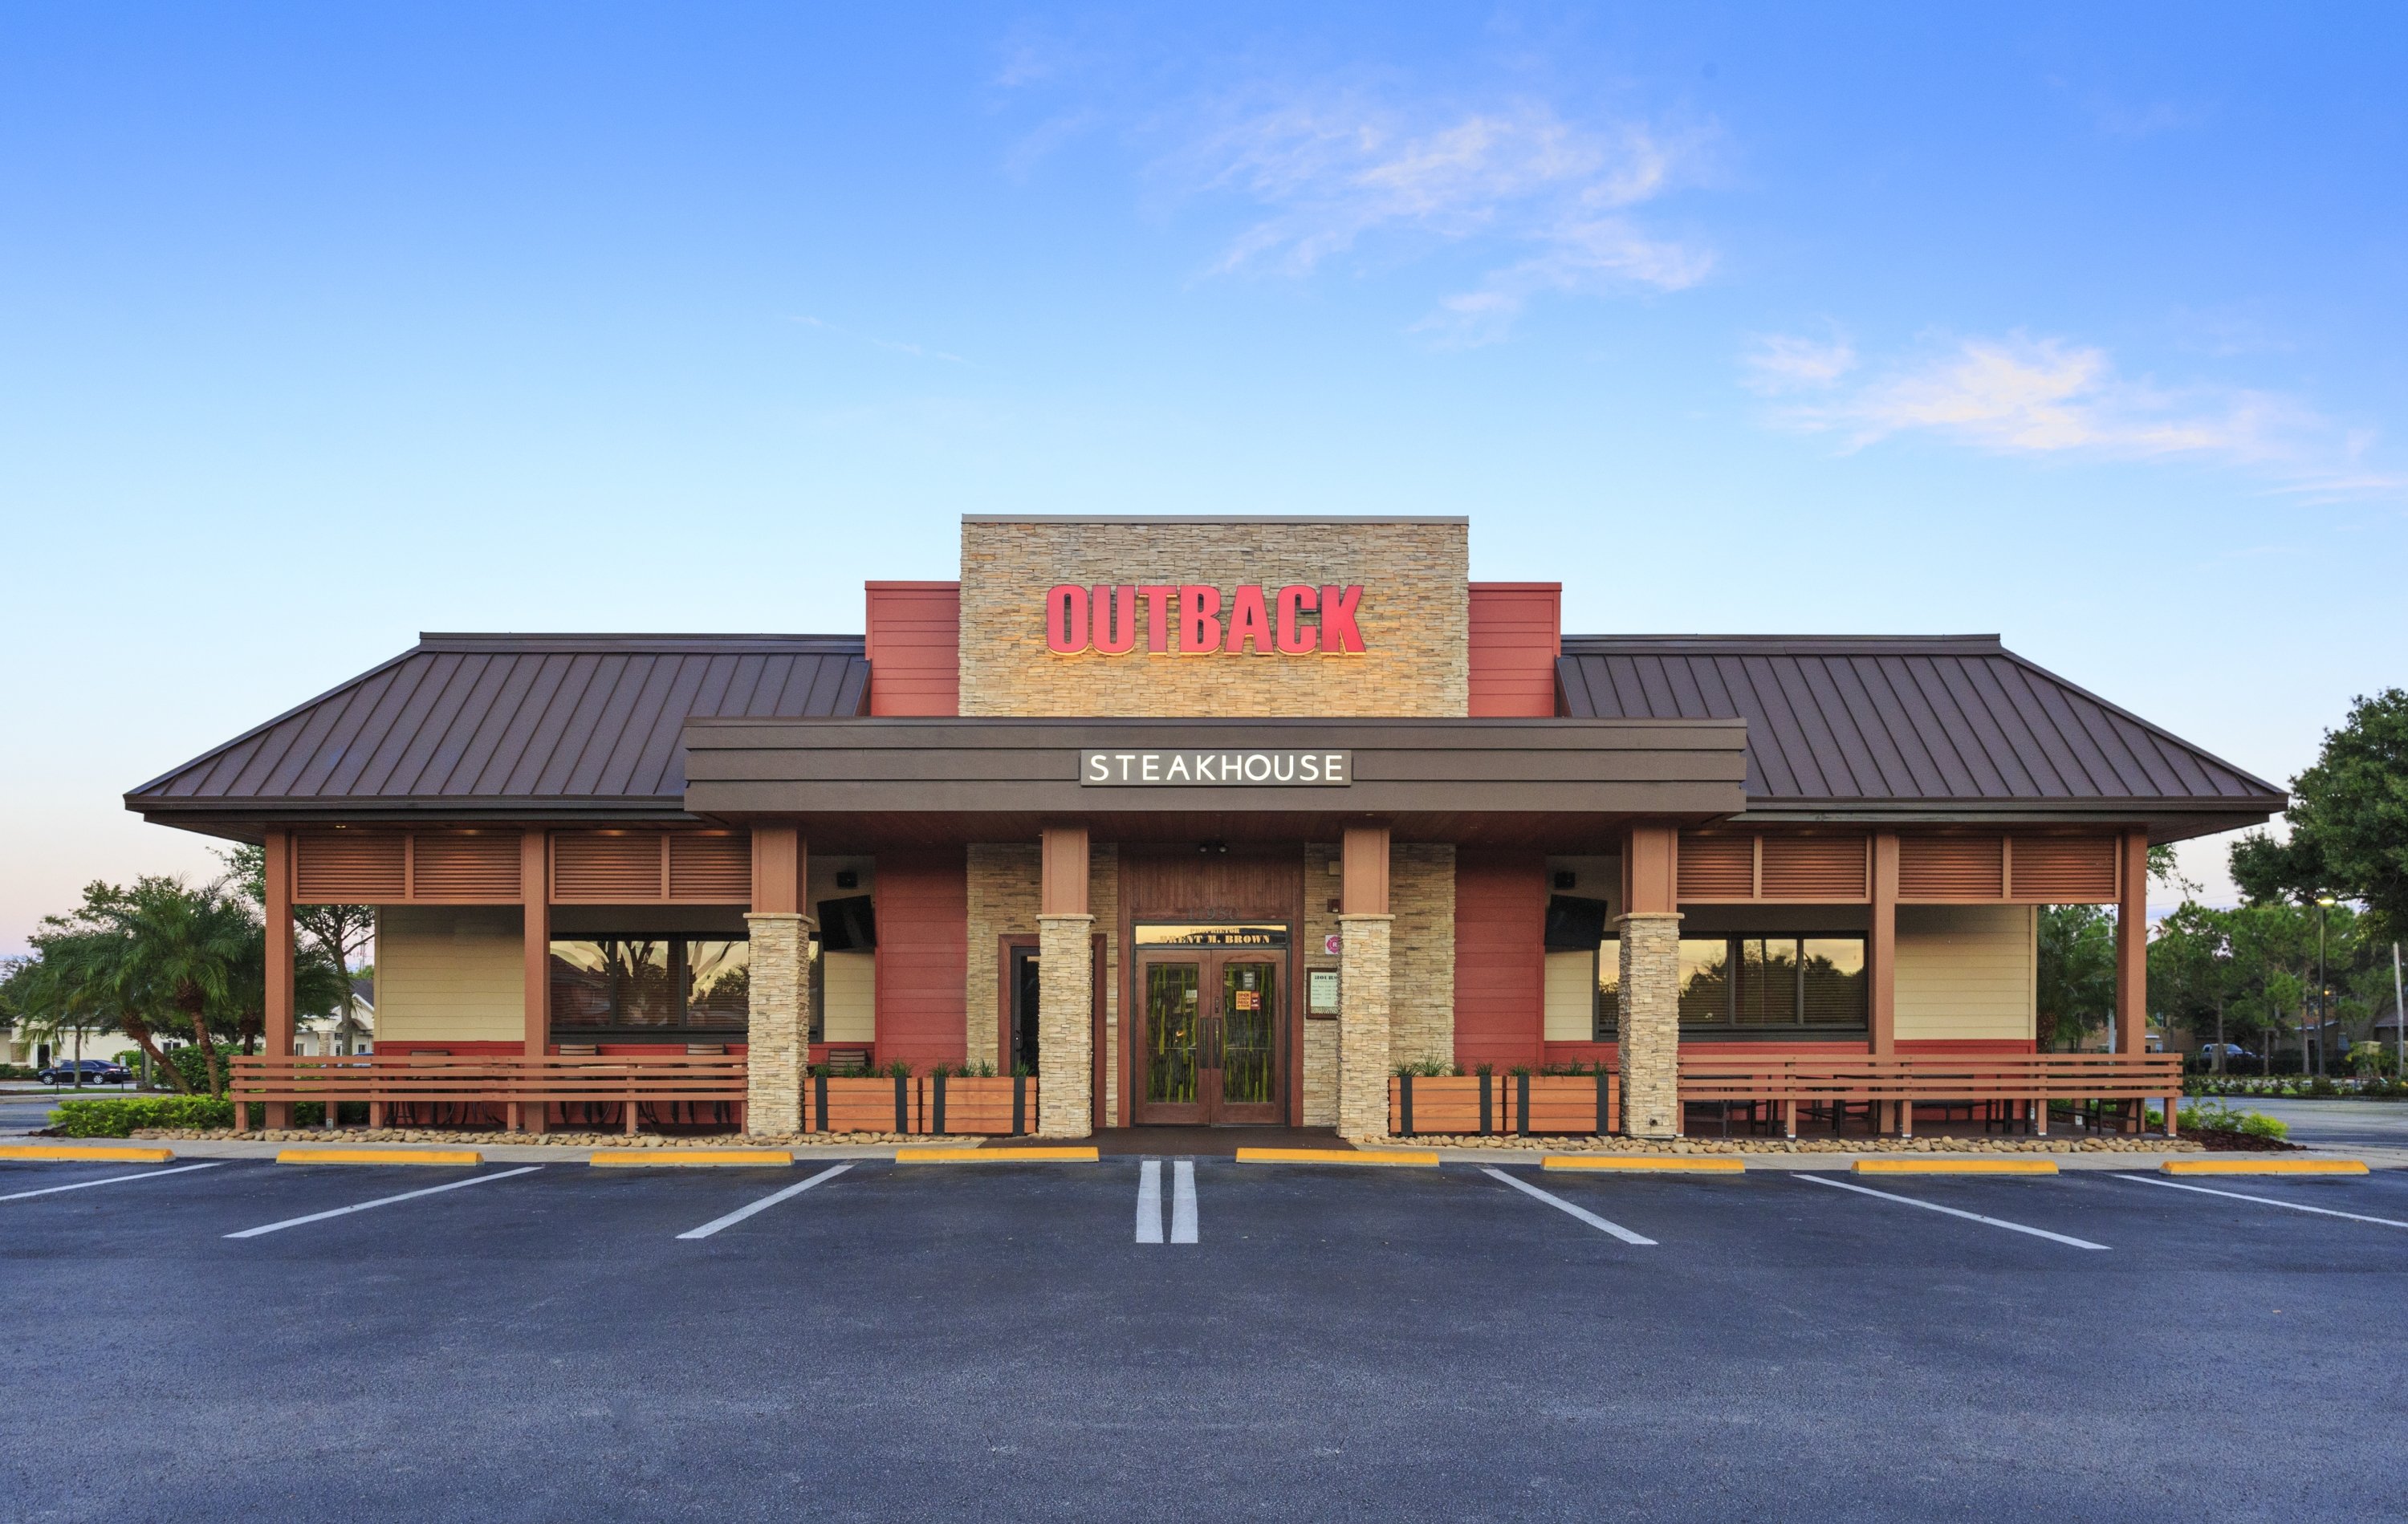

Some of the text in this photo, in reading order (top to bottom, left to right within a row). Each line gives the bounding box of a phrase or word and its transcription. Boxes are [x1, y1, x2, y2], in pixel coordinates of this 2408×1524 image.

[1047, 584, 1366, 655] OUTBACK
[1089, 755, 1343, 781] STEAKHOUSE
[1160, 935, 1270, 944] BRENT M. BROWN
